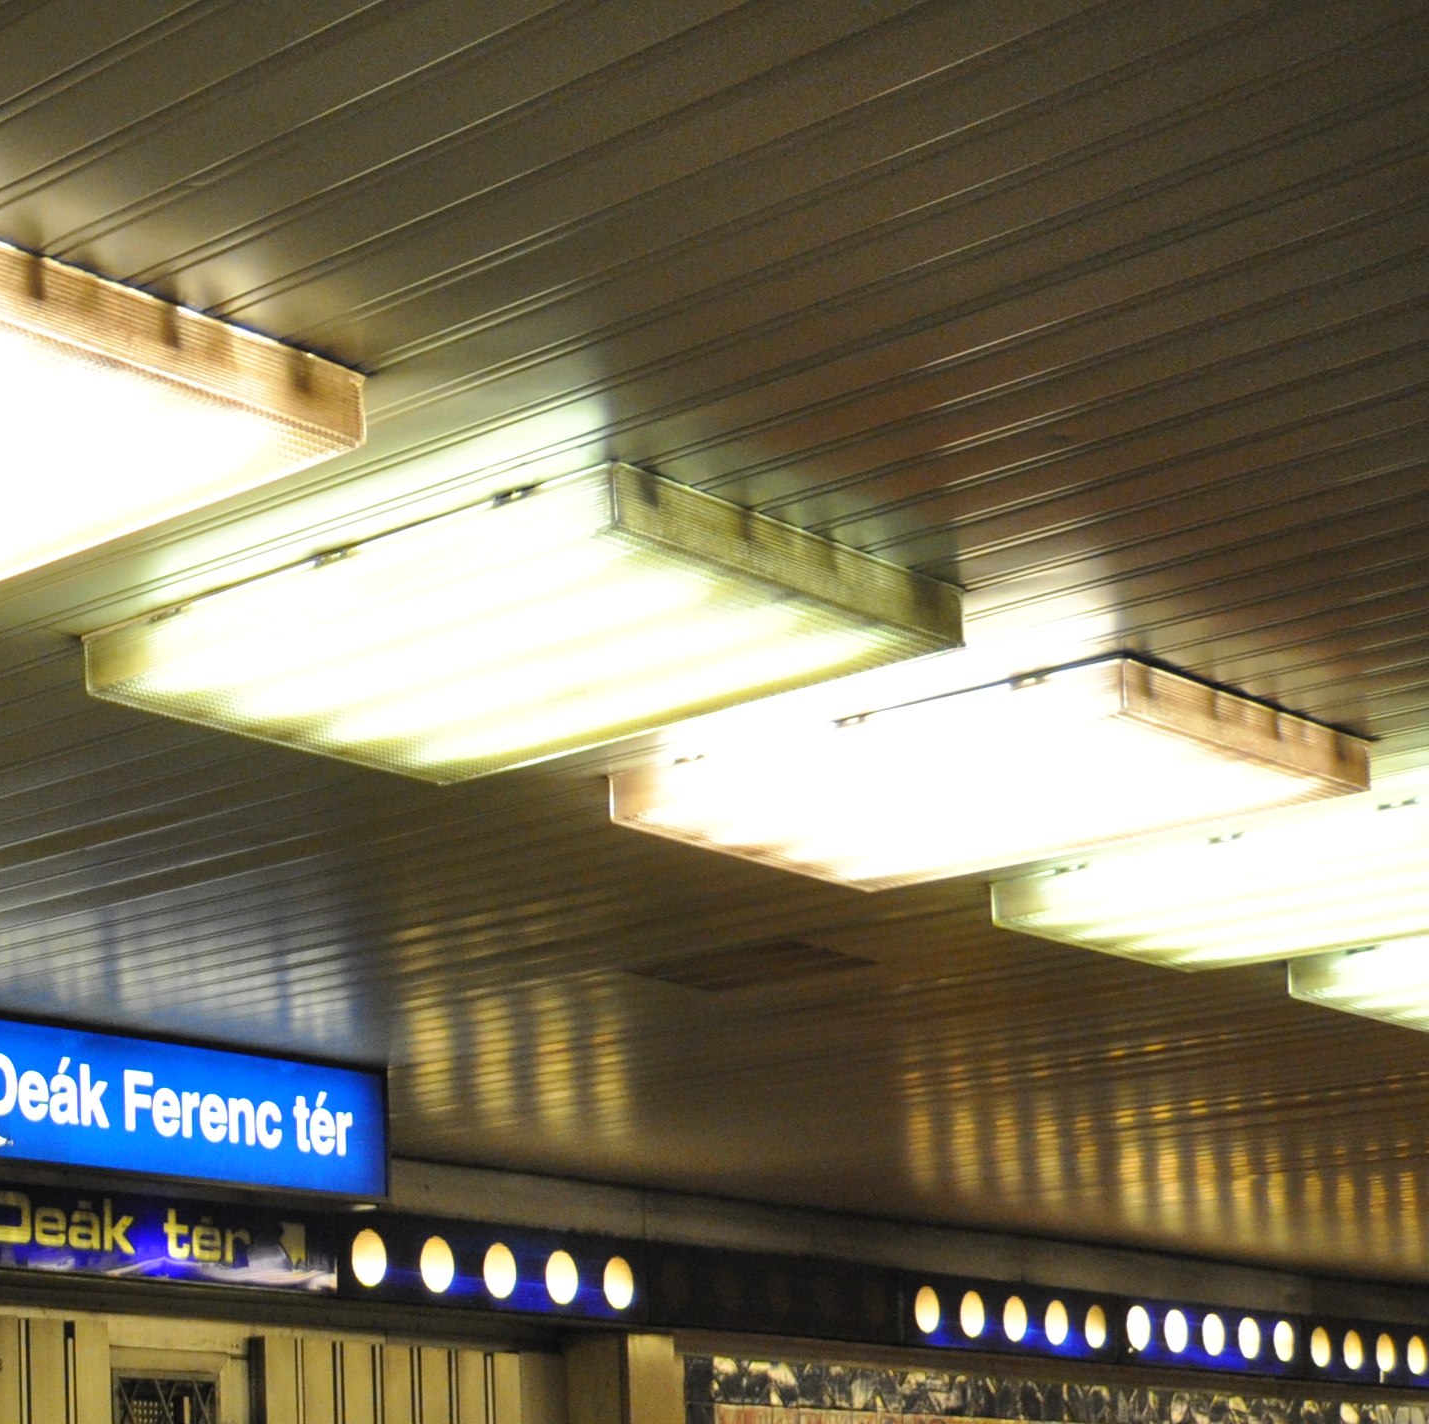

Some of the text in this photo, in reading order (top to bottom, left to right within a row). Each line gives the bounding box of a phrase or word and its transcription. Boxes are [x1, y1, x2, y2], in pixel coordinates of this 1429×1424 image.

[123, 1070, 283, 1149] Ferenc
[292, 1092, 353, 1156] tér
[163, 1208, 253, 1264] tér
